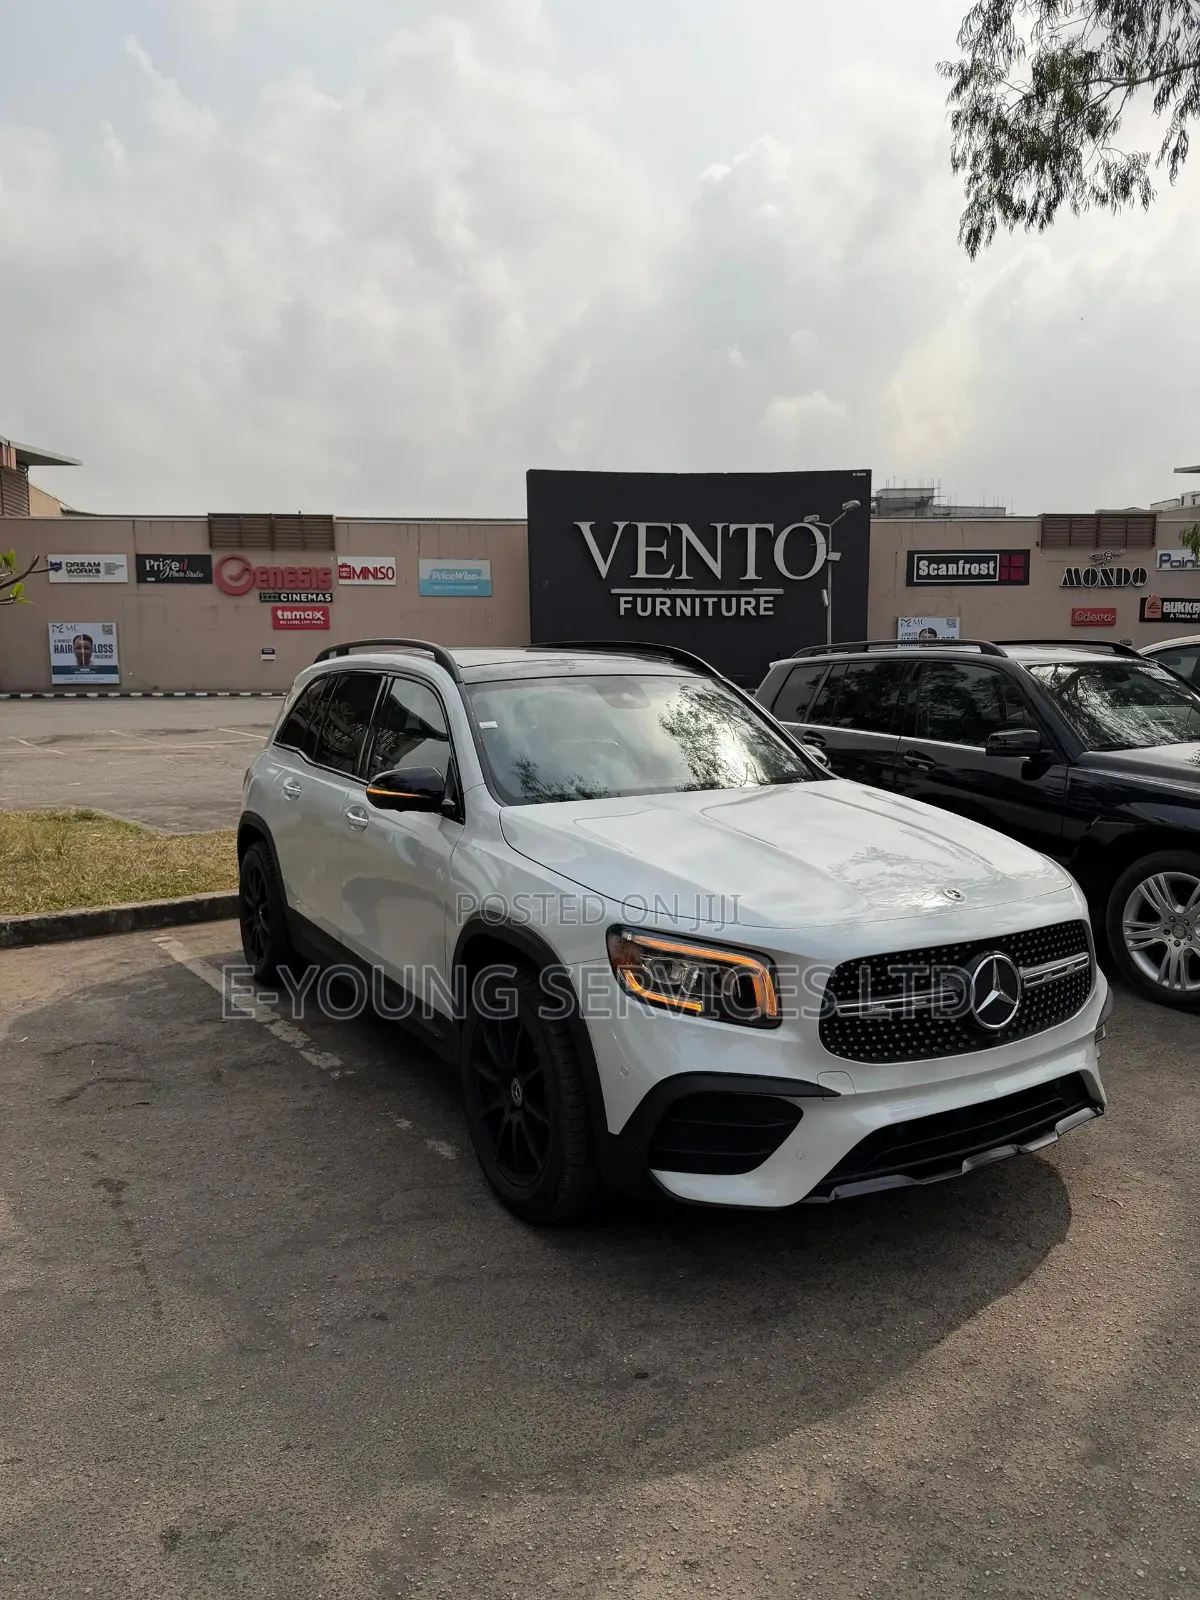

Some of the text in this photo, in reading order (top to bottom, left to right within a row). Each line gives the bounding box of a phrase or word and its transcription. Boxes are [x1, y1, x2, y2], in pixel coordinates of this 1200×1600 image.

[573, 521, 827, 580] VENTO
[185, 570, 204, 578] Studio
[352, 566, 395, 580] MINISO
[918, 560, 995, 576] Scanfrost
[432, 571, 478, 580] PriceWise
[1060, 567, 1148, 588] MONDO
[280, 593, 331, 602] CINEMAS
[619, 596, 774, 617] FURNITURE
[1163, 601, 1200, 613] BUKKA
[65, 624, 80, 632] MC
[54, 643, 114, 654] HAIR LOSS
